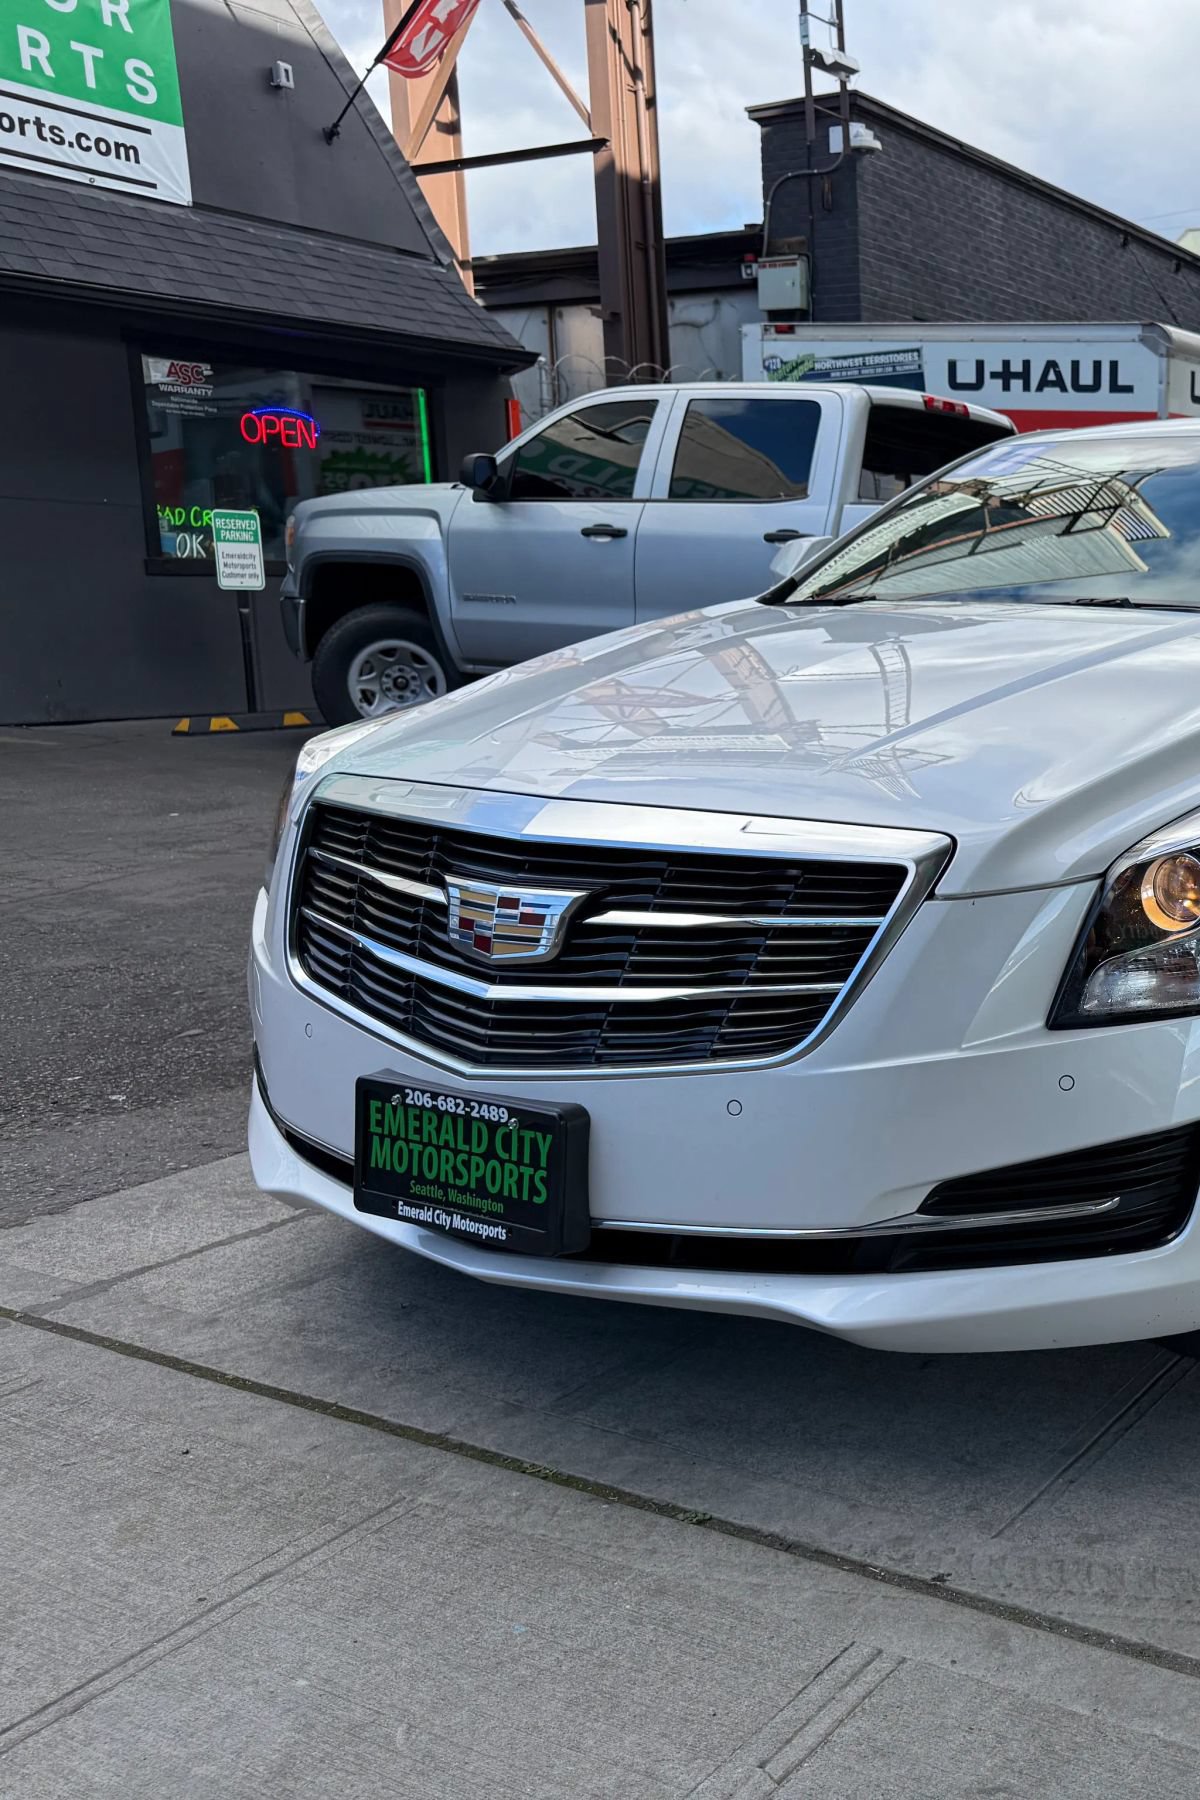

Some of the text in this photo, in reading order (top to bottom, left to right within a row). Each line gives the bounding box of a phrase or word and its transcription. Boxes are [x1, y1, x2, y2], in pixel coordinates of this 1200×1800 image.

[166, 361, 205, 386] ASC
[814, 357, 864, 371] NORTHWEST
[864, 351, 919, 366] TERRITORIES
[947, 358, 1135, 394] U-HAUL
[158, 384, 213, 397] WARRANTY
[240, 412, 317, 449] OPEN
[215, 518, 257, 530] RESERVED
[220, 530, 254, 542] PARKING
[176, 533, 206, 558] OK
[221, 571, 247, 579] Customer
[223, 561, 257, 570] Motorsports
[404, 1088, 509, 1123] 206-682-2489
[369, 1100, 553, 1167] EMERALD CITY
[370, 1135, 548, 1205] MOTORSPORTS
[409, 1180, 446, 1202] Seattle,
[447, 1188, 504, 1214] Washington
[397, 1200, 433, 1223] Emerald
[433, 1209, 452, 1230] City
[452, 1213, 507, 1240] Motorsports
